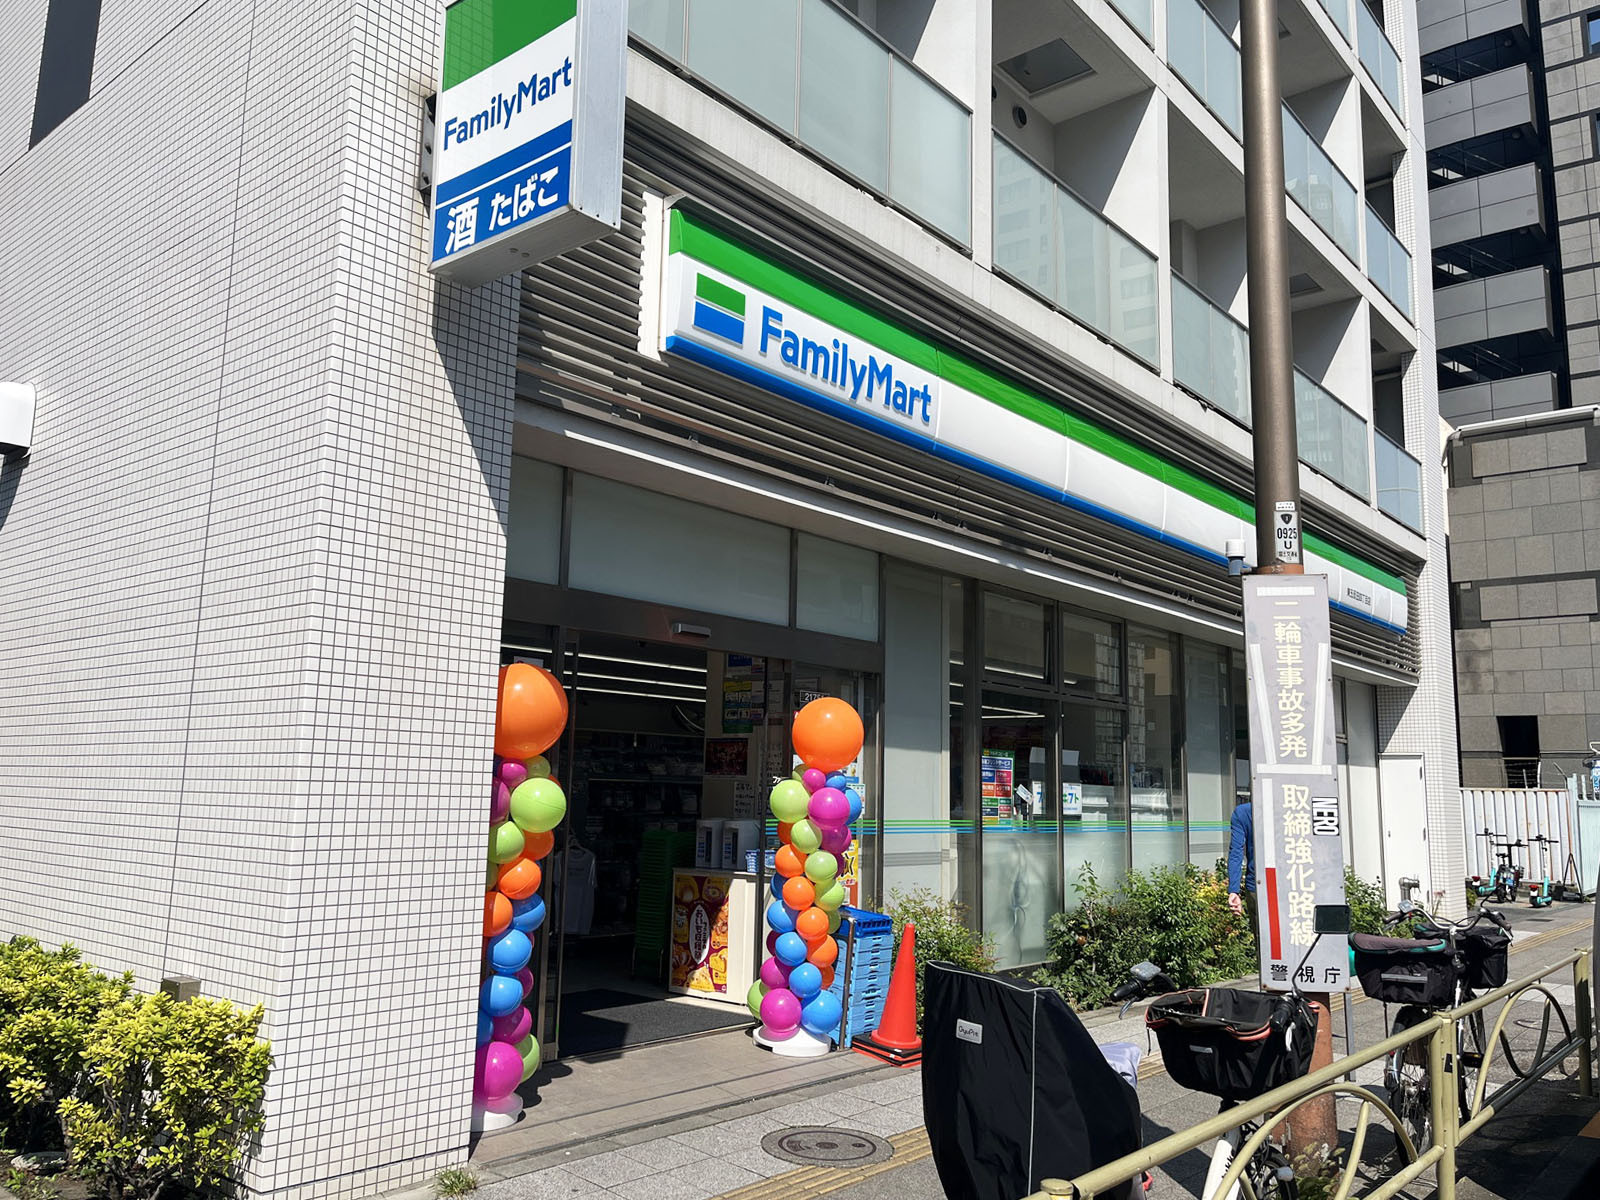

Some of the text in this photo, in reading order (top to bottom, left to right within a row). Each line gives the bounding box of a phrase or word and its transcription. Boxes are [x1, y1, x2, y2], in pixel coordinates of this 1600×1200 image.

[443, 56, 572, 151] FamilyMart
[445, 166, 559, 254] 酒 たばこ
[760, 305, 932, 424] FamilyMart
[1277, 527, 1297, 540] 0925
[1284, 541, 1292, 550] U
[1273, 601, 1308, 758] 二輪車事故多発
[1312, 798, 1339, 836] NERO
[1282, 784, 1319, 947] 取締強化路線
[1270, 964, 1341, 985] 警視庁
